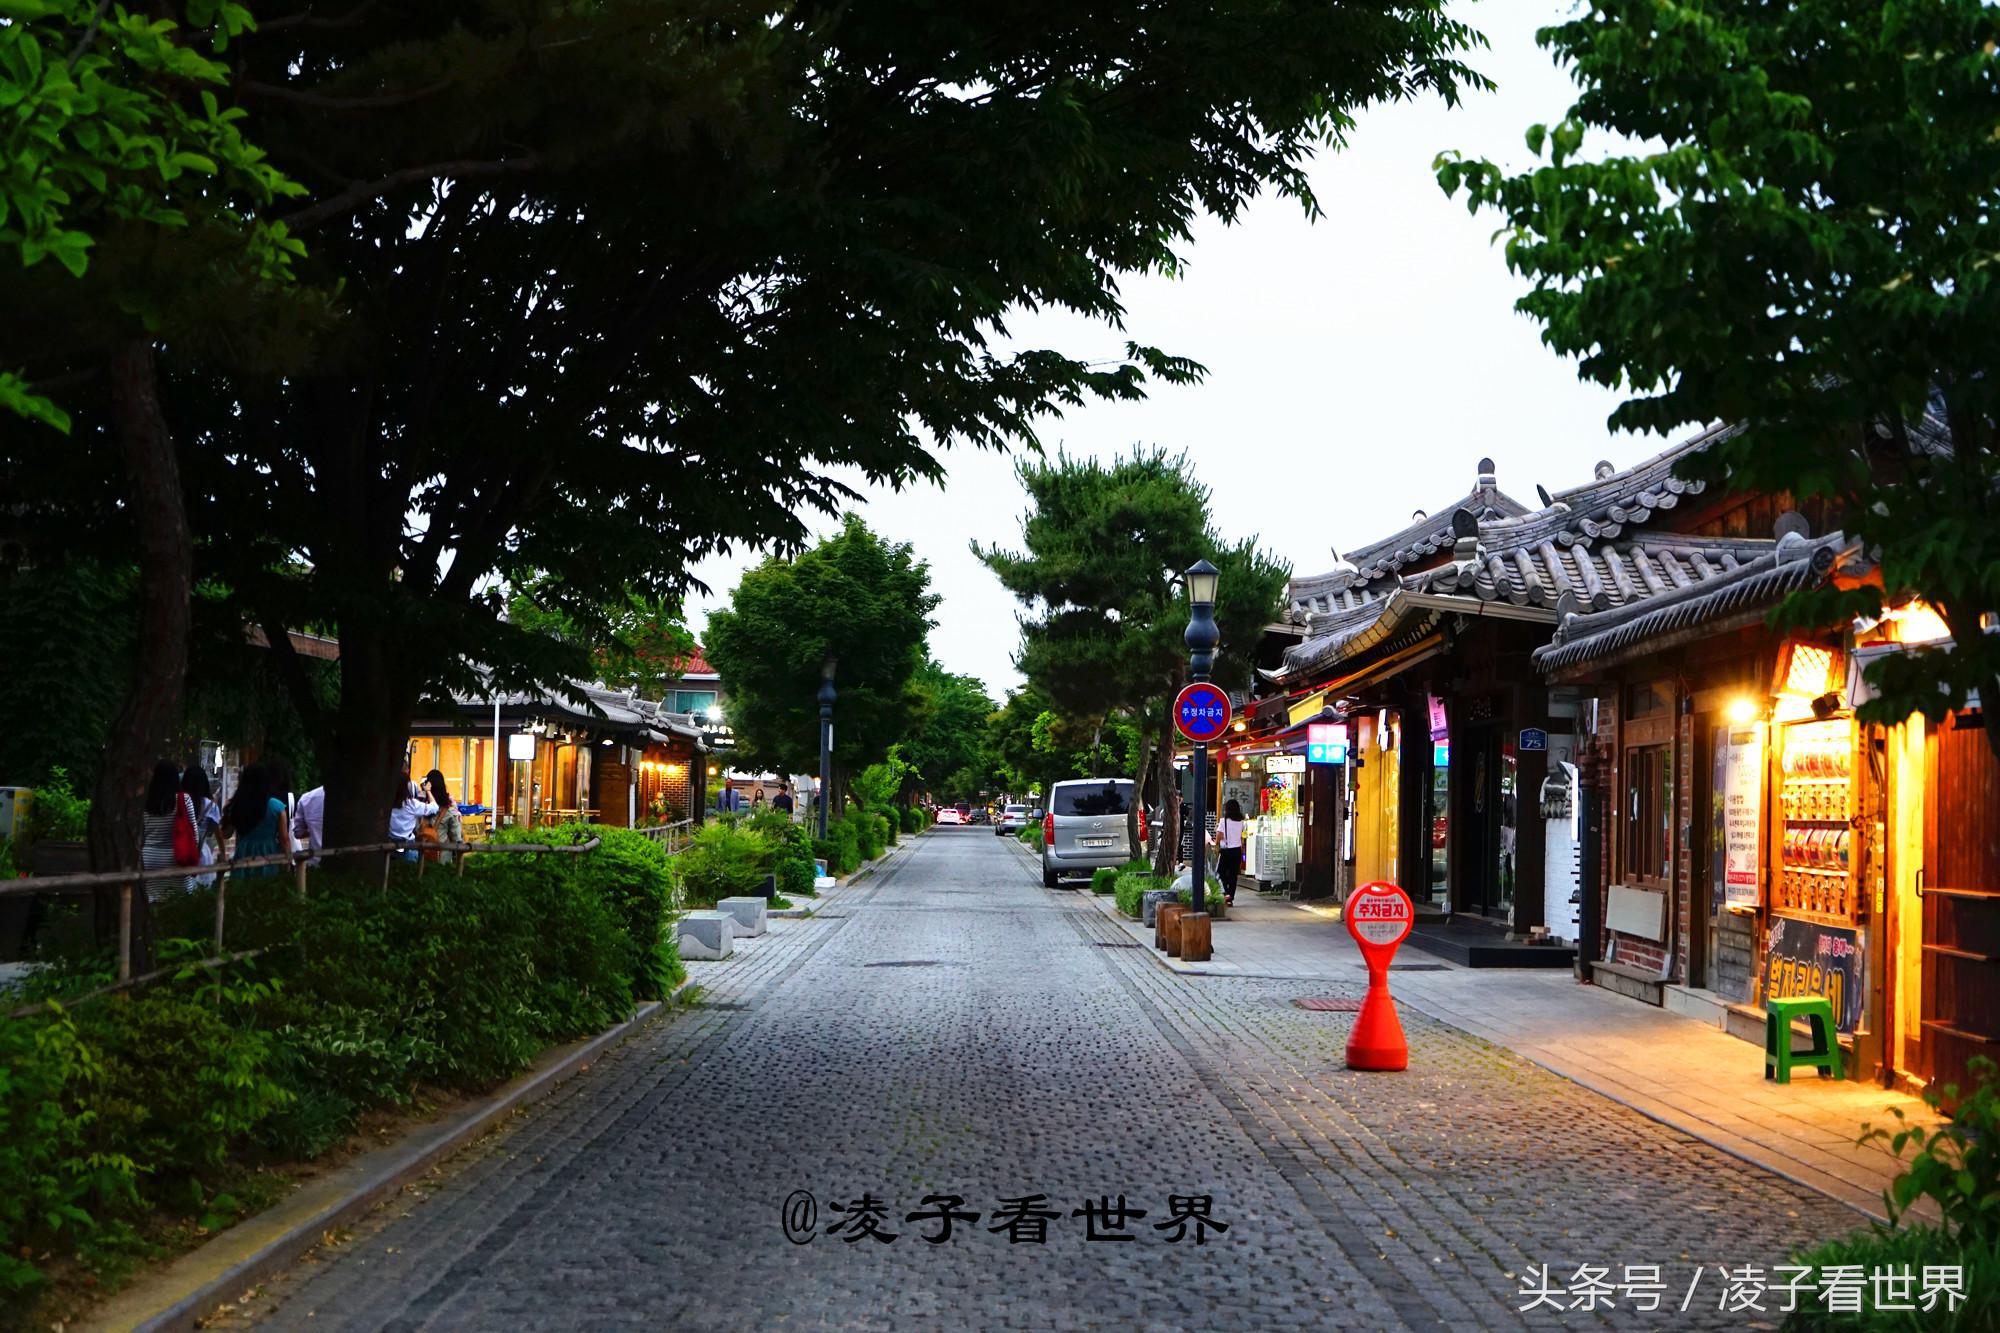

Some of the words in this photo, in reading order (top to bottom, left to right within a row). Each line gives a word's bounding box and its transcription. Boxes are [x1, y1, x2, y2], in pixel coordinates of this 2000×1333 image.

[1182, 707, 1223, 717] 주정차금지
[1525, 739, 1541, 748] 75
[1359, 903, 1404, 917] 주차금지
